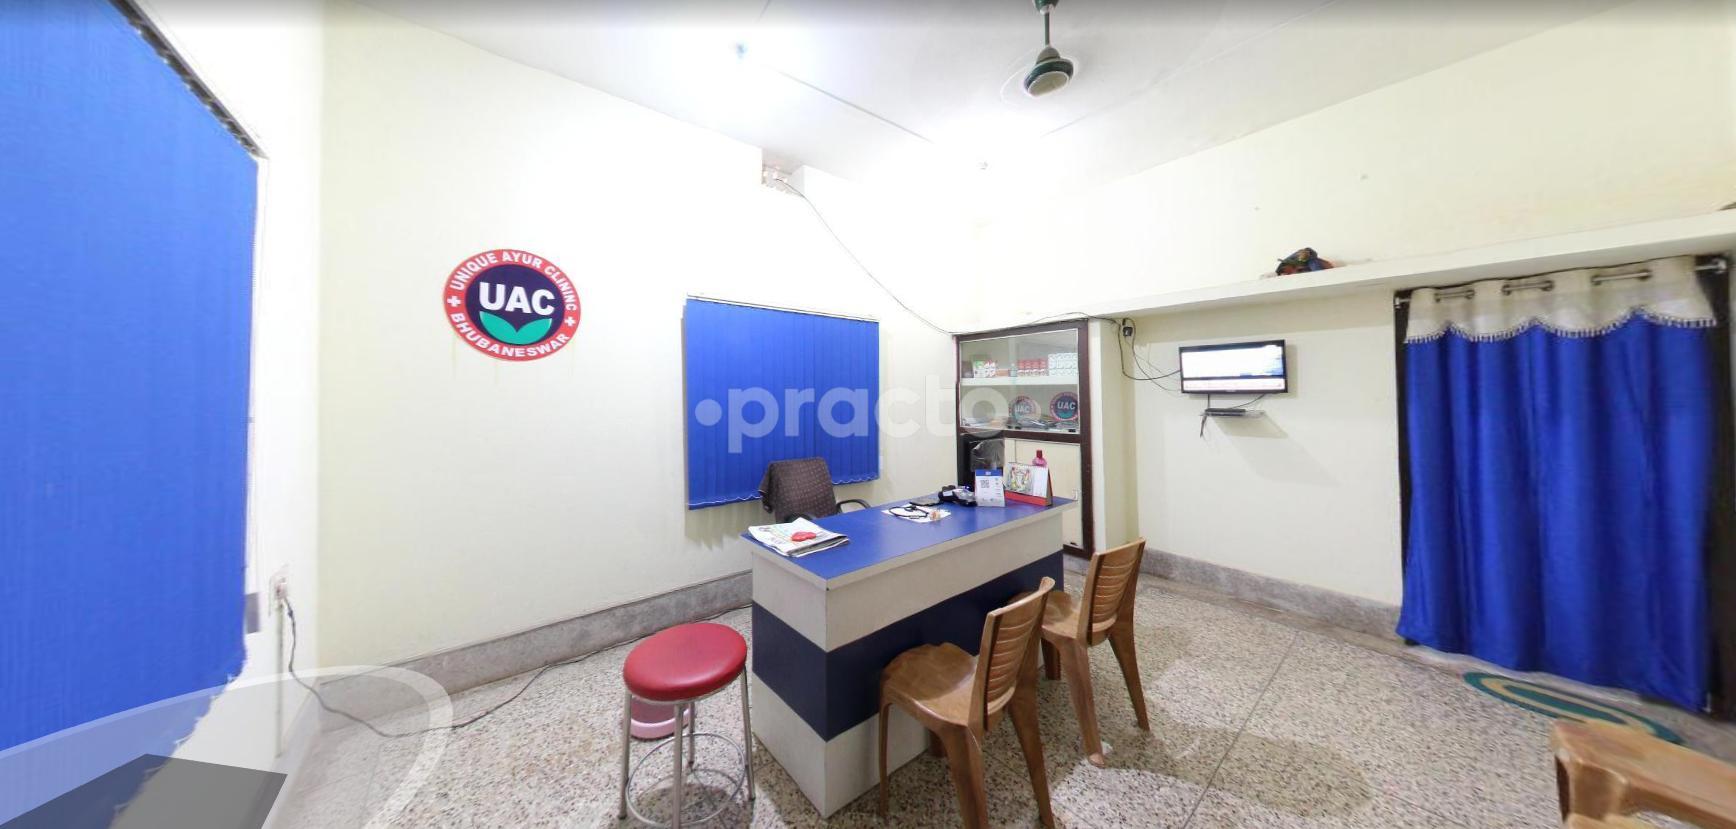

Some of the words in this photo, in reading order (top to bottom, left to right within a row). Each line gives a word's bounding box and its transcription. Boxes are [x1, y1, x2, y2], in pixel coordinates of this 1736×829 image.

[450, 252, 498, 291] UNIQUE
[502, 251, 542, 268] AYUR
[479, 282, 555, 316] UAC
[451, 312, 570, 357] BHUBANESWAR
[1057, 401, 1076, 410] UAC
